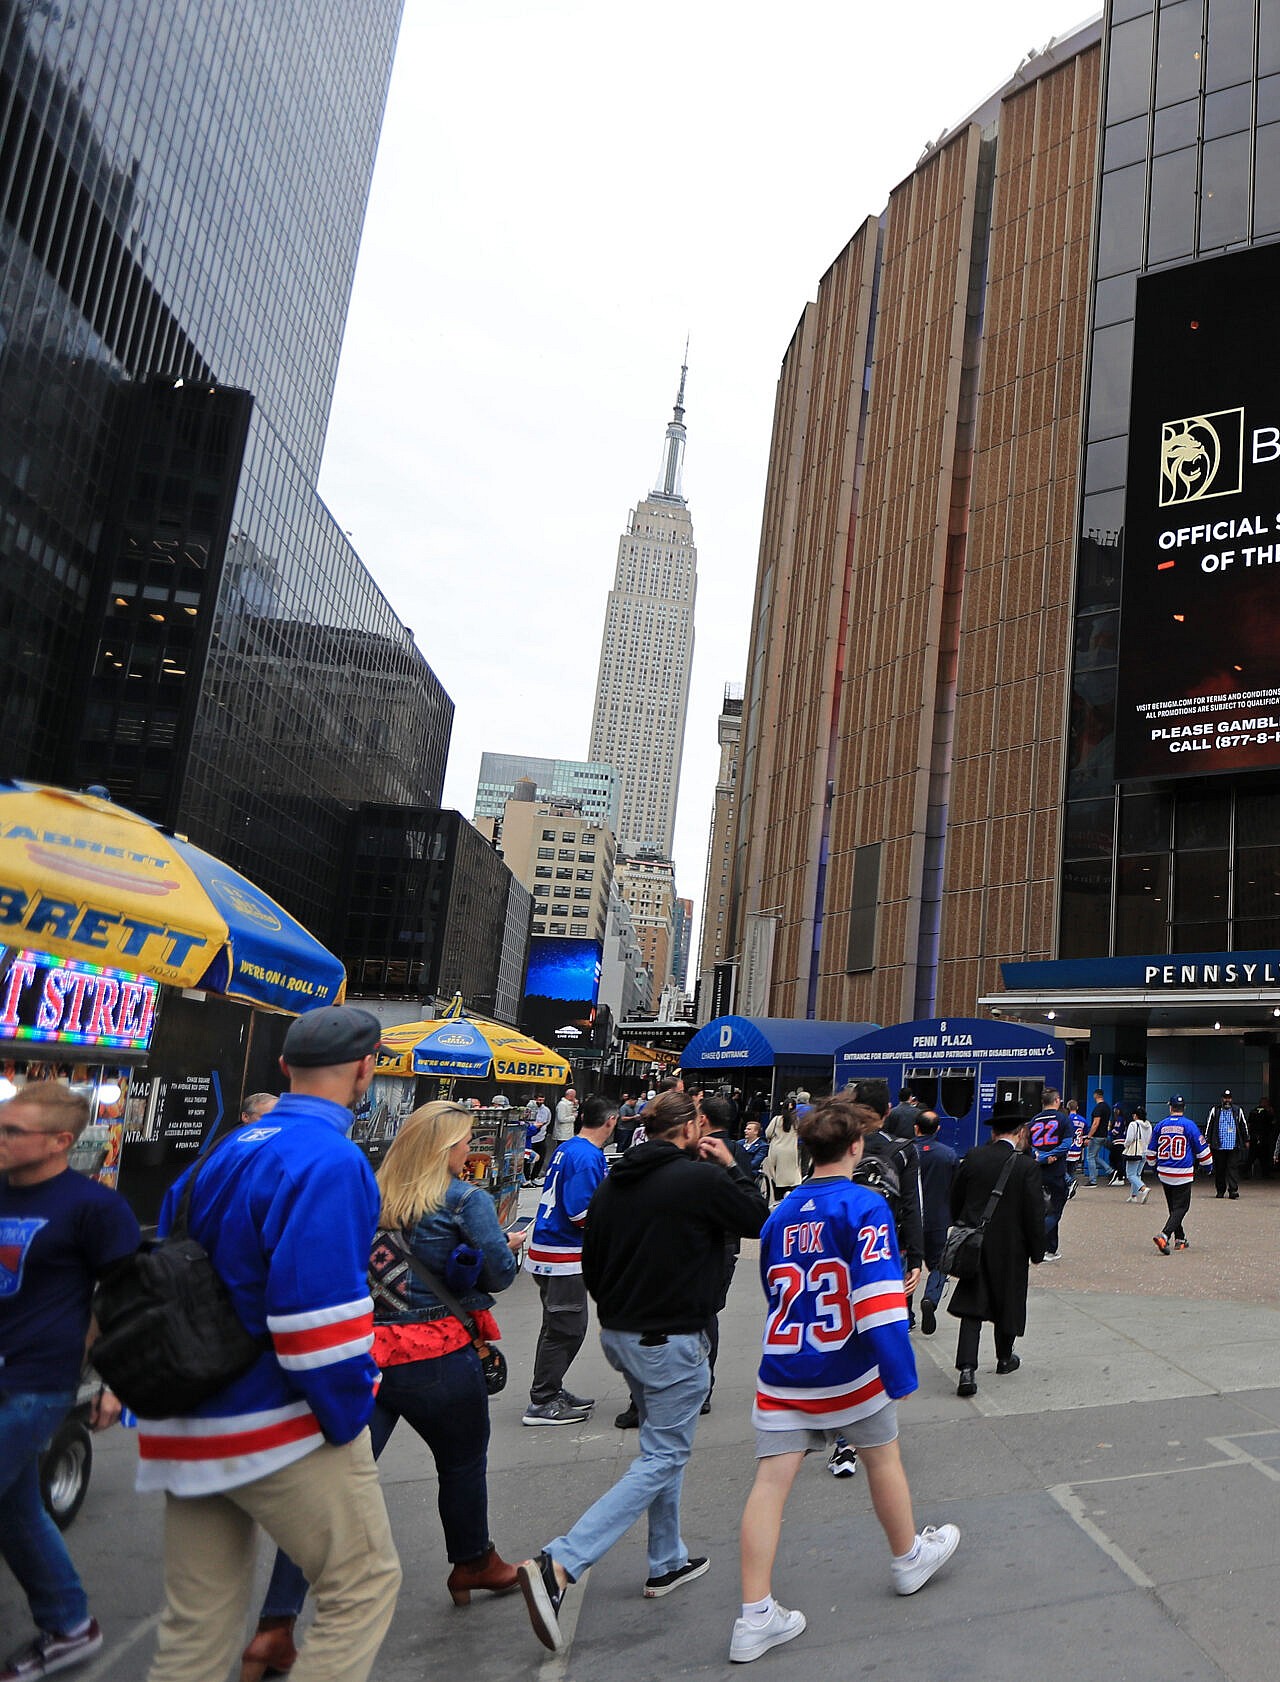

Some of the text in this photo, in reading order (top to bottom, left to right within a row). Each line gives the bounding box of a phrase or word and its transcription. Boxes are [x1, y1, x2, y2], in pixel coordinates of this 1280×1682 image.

[1158, 516, 1268, 550] OFFICIAL
[1200, 551, 1235, 572] OF
[1136, 703, 1152, 712] VISIT
[1152, 698, 1192, 710] BETMGM.COM
[1206, 695, 1226, 703] TERMS
[1228, 692, 1242, 700] AND
[1146, 711, 1156, 719] ALL
[1158, 706, 1196, 718] PROMOTIONS
[1198, 704, 1210, 712] ARE
[1210, 702, 1236, 712] SUBJECT
[1152, 723, 1214, 740] PLEASE
[1169, 738, 1212, 753] CALL
[0, 823, 169, 868] ABRETT
[148, 964, 178, 979] 2020
[266, 970, 281, 985] ON
[286, 977, 314, 995] ROLL
[719, 1025, 732, 1048] D
[940, 1022, 946, 1032] 8
[913, 1034, 972, 1047] PENN PLAZA
[721, 1050, 749, 1059] ENTRANCE
[882, 1052, 914, 1060] EMPLOYEES,
[989, 1048, 1028, 1057] DISABILITIES
[498, 1061, 566, 1078] SABRETT
[1030, 1120, 1059, 1146] 22
[1158, 1135, 1186, 1160] 20
[784, 1222, 825, 1258] FOX
[858, 1224, 892, 1264] 23
[762, 1257, 856, 1355] 23
